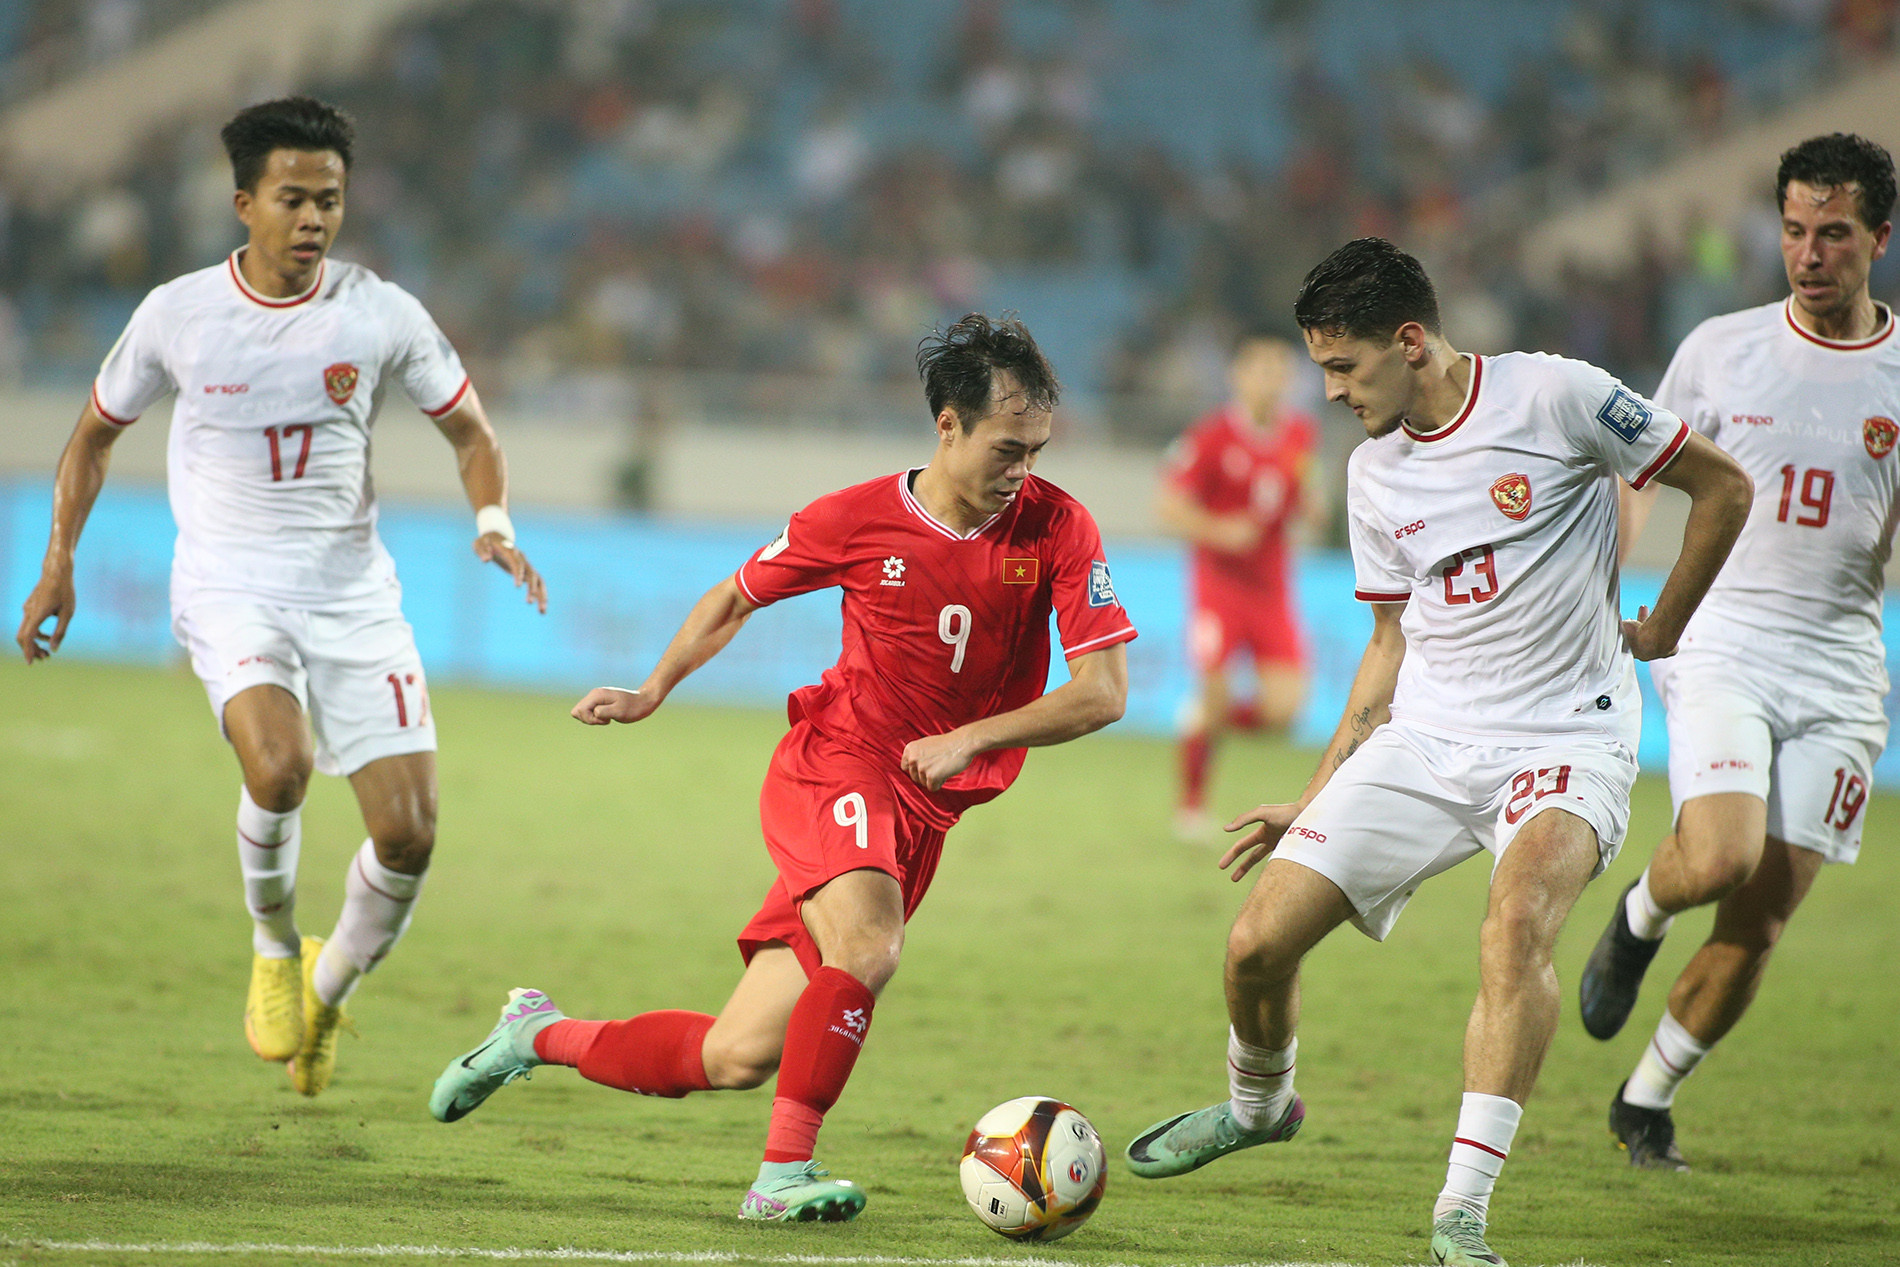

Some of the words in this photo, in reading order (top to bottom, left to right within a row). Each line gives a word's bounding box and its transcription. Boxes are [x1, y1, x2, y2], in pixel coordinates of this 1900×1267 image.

[1732, 414, 1774, 426] erspo
[264, 424, 313, 482] 17
[1777, 464, 1835, 528] 19
[1394, 519, 1426, 539] erspo
[1442, 543, 1498, 605] 23
[938, 604, 972, 673] 9
[833, 792, 868, 849] 9
[1505, 765, 1571, 825] 23
[1824, 767, 1866, 831] 19
